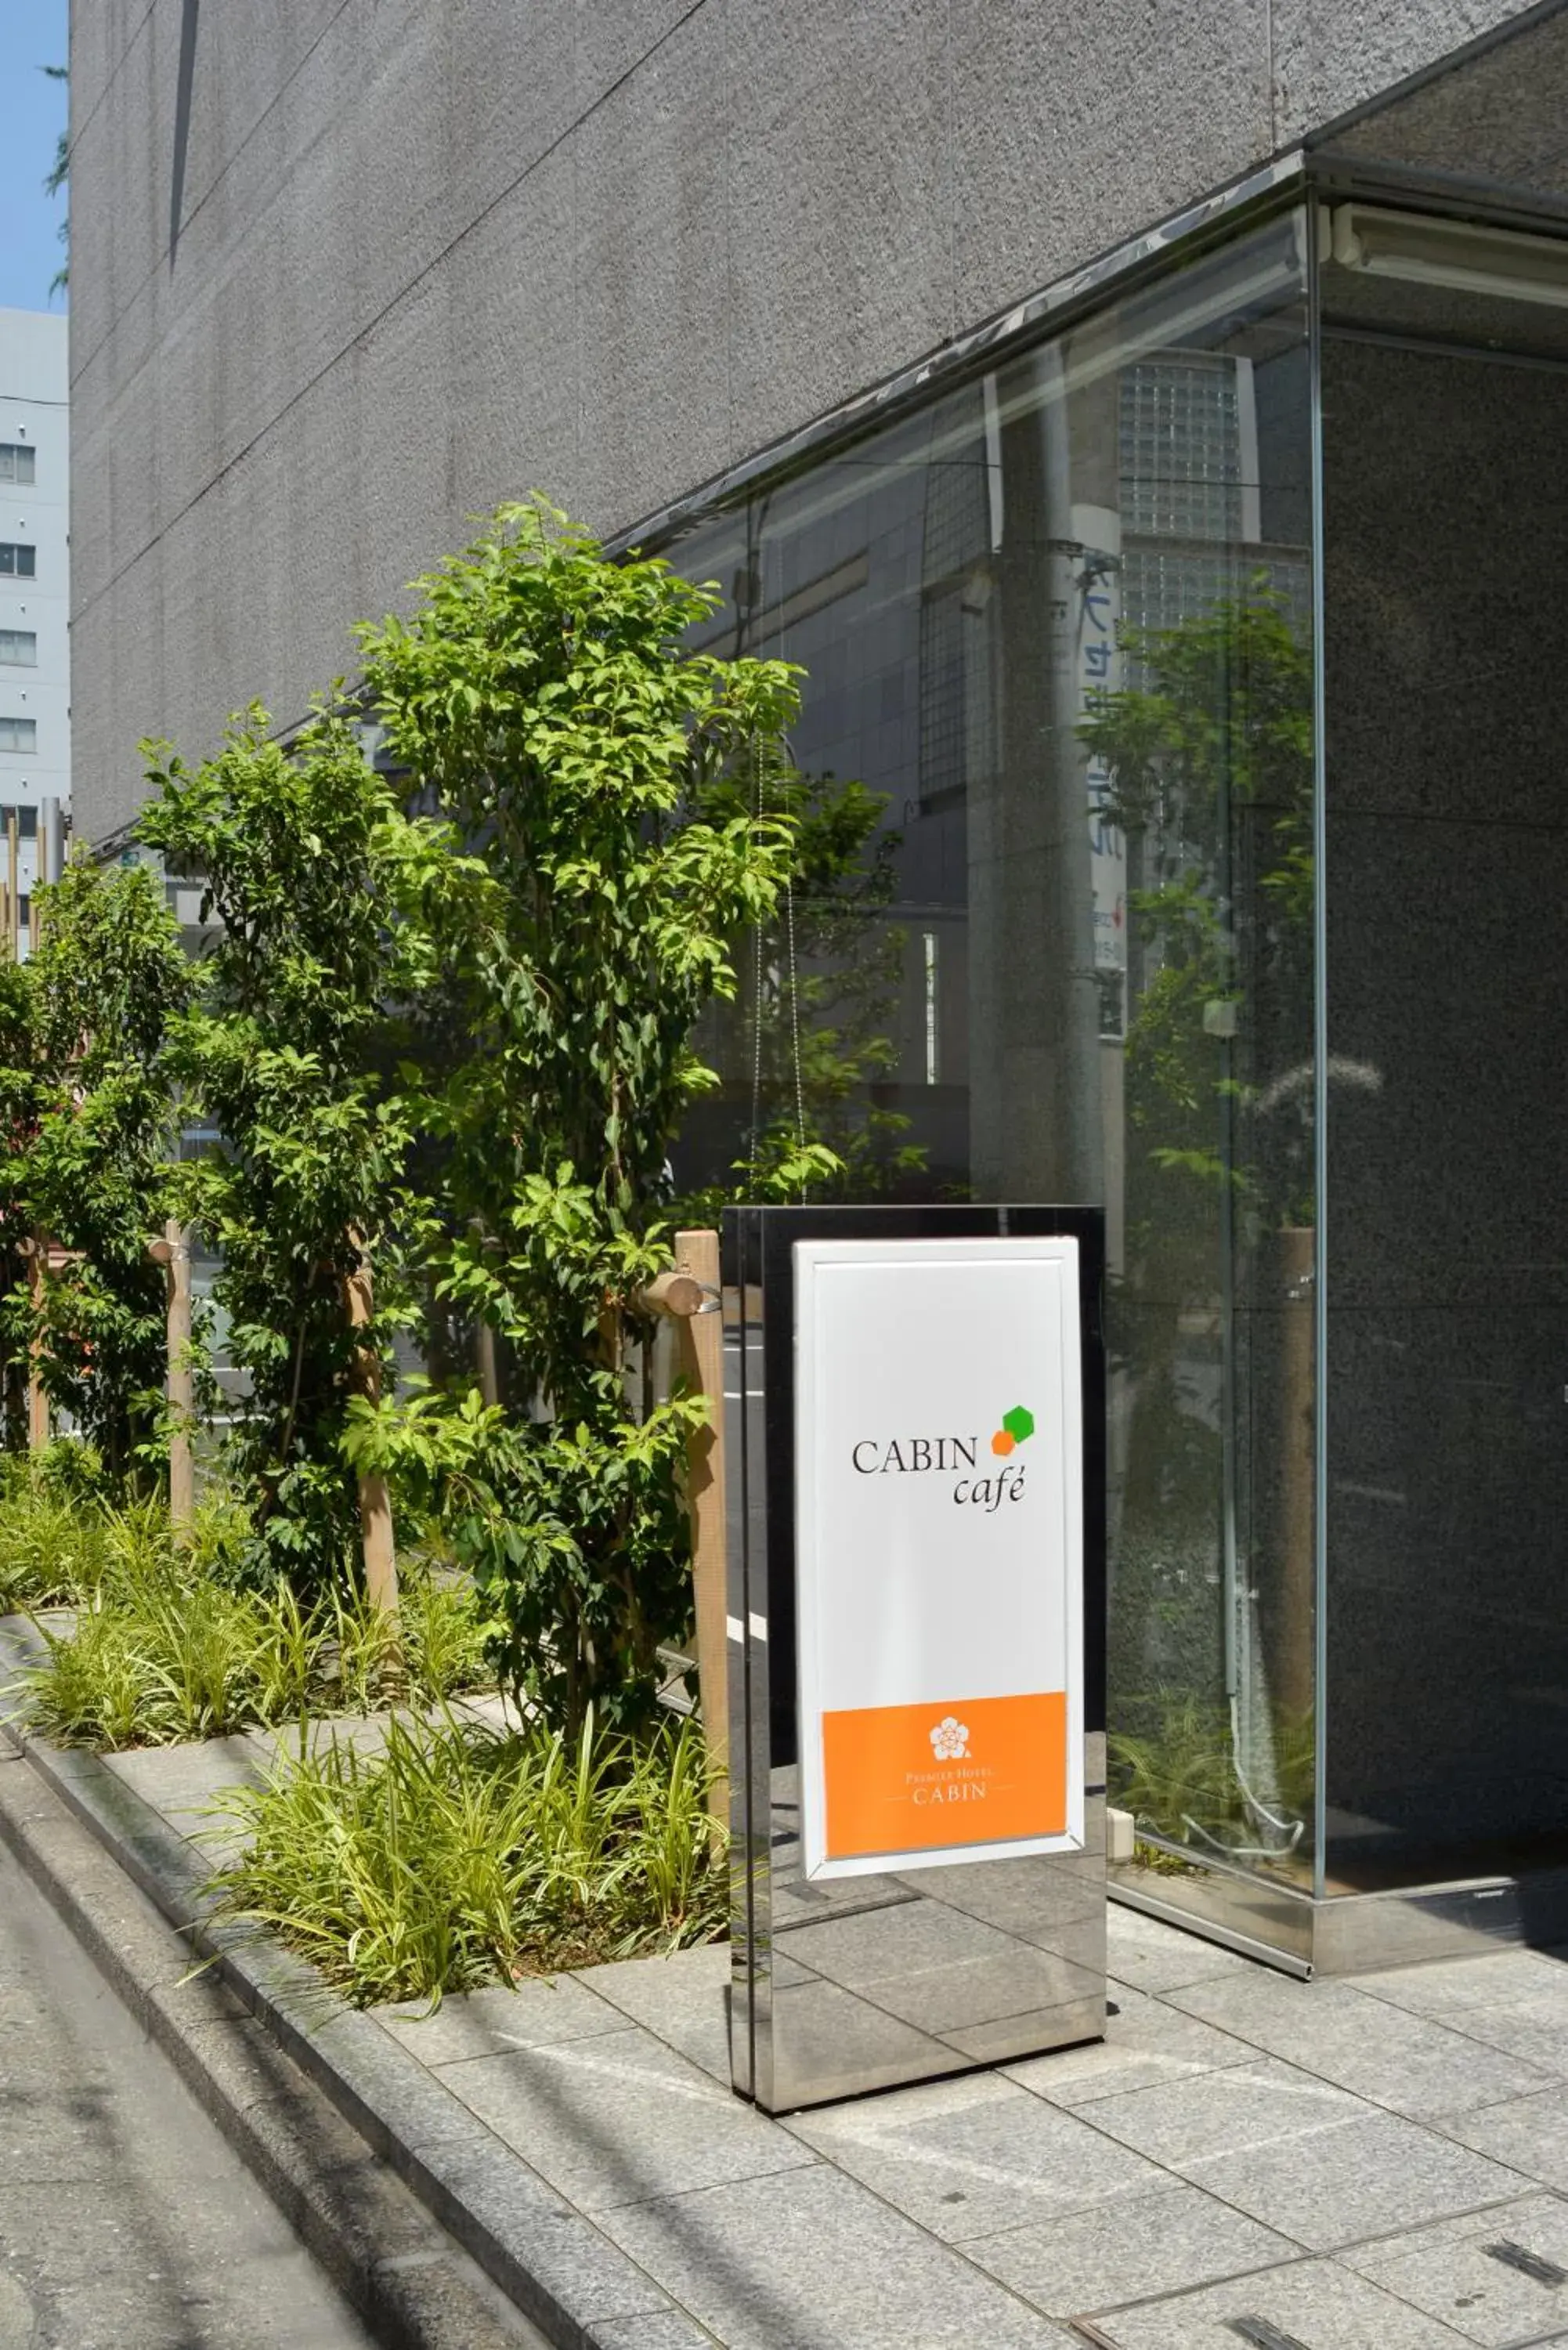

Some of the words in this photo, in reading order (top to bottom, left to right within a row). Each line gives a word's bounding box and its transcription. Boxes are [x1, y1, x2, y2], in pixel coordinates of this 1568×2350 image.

[852, 1437, 977, 1473] CABIN
[953, 1466, 1026, 1513] café
[913, 1782, 986, 1805] CABIN
